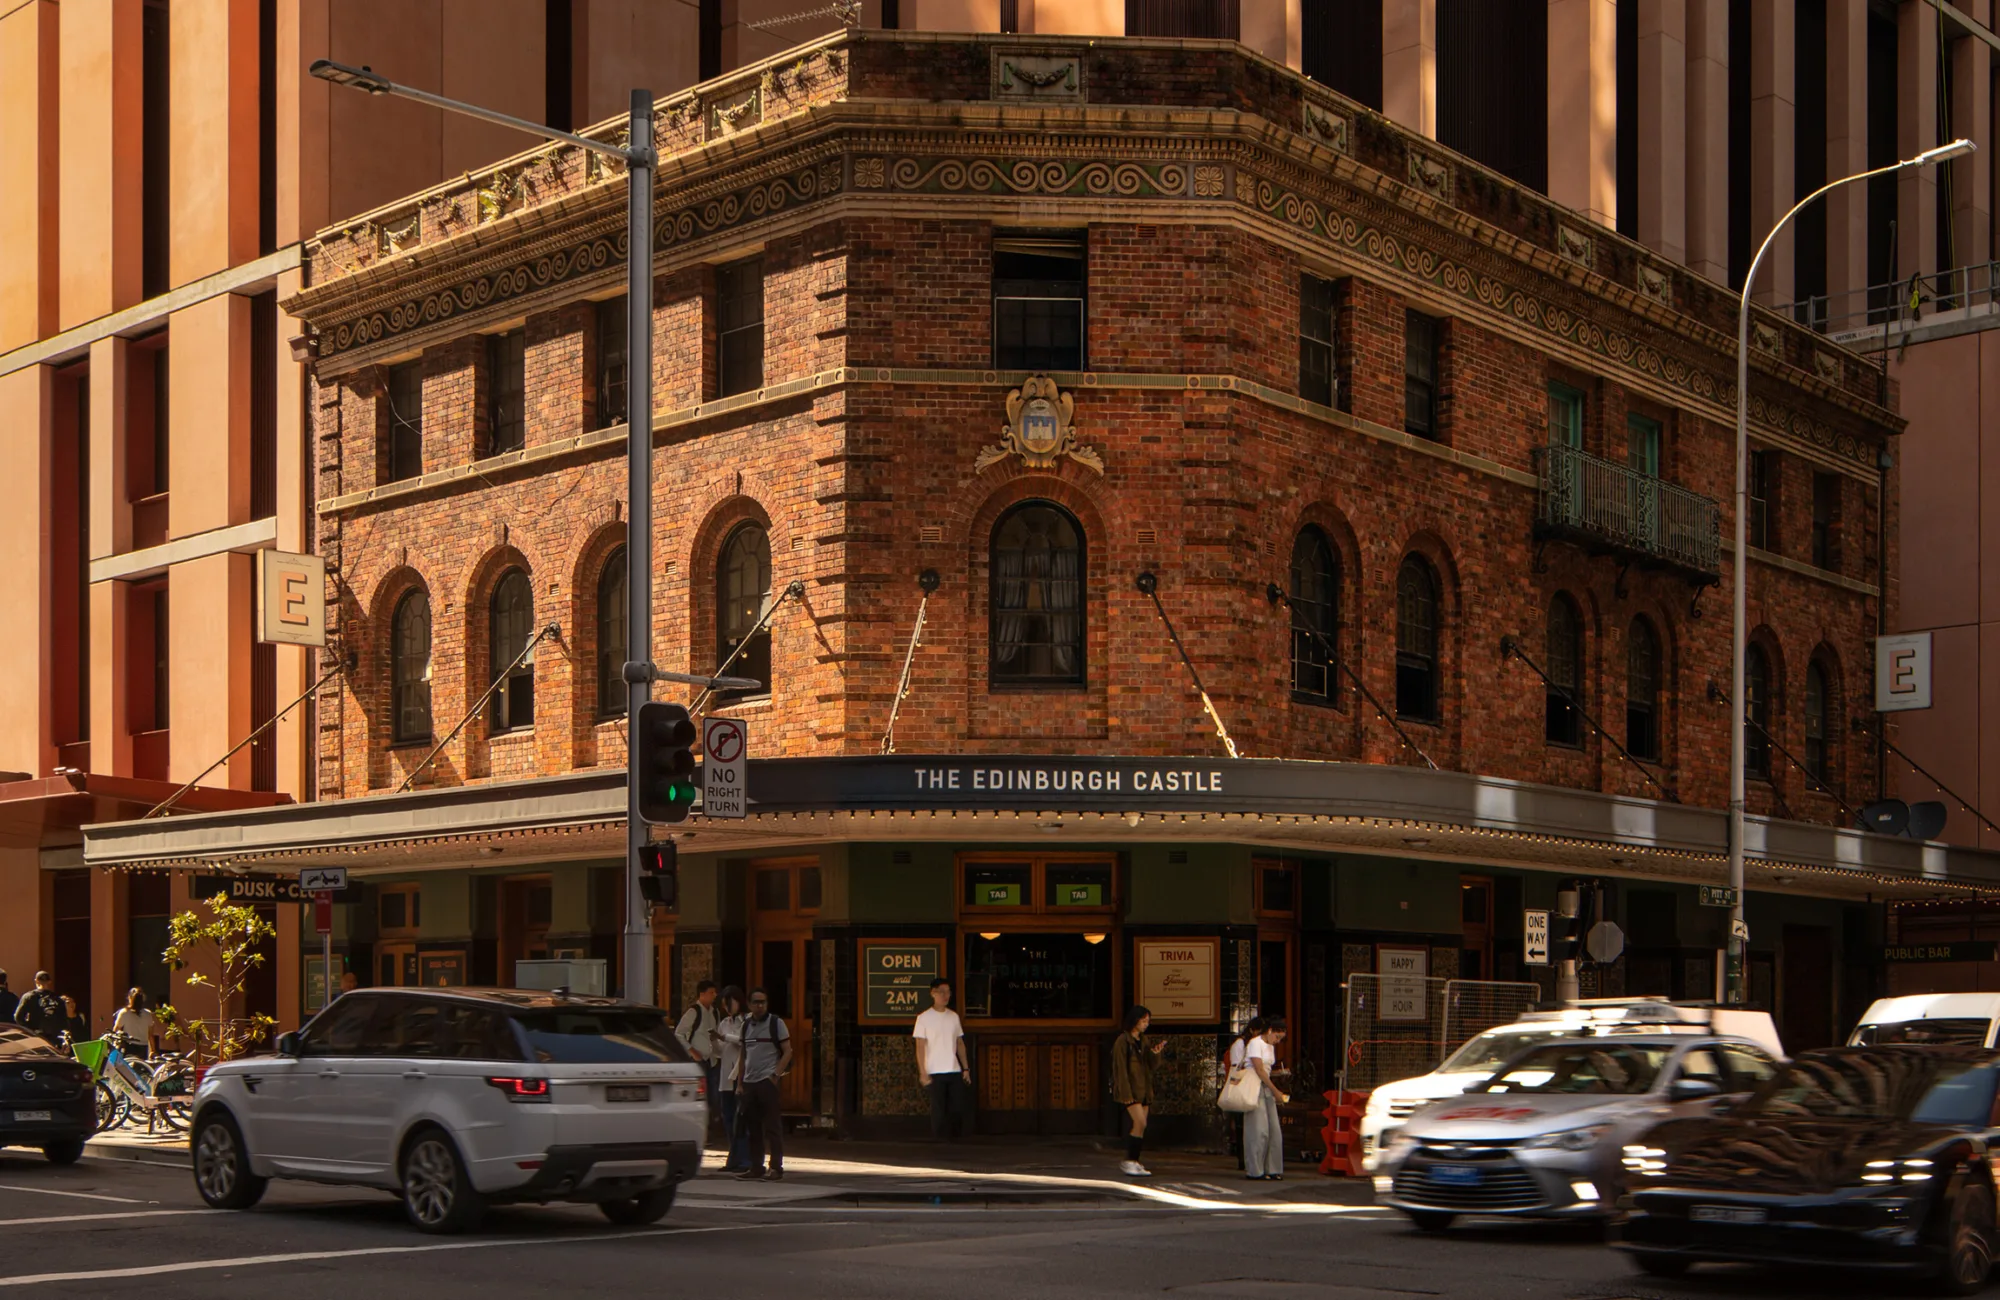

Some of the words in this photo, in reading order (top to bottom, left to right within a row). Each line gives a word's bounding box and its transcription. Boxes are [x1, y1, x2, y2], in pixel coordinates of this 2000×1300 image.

[279, 571, 308, 626] E
[1889, 649, 1916, 694] E
[712, 768, 736, 783] NO
[914, 769, 961, 789] THE
[972, 769, 1121, 792] EDINBURGH
[1133, 770, 1223, 792] CASTLE
[707, 786, 741, 798] RIGHT
[708, 800, 739, 812] TURN
[232, 880, 276, 898] DUSK
[990, 891, 1007, 899] TAB
[1071, 891, 1087, 899] TAB
[1528, 915, 1545, 928] ONE
[1527, 932, 1546, 945] WAY
[1029, 950, 1048, 959] THE
[1159, 950, 1195, 961] TRIVIA
[1884, 947, 1926, 960] PUBLIC
[1928, 946, 1951, 958] BAR
[881, 954, 922, 969] OPEN
[1391, 957, 1415, 970] HAPPY
[1023, 981, 1053, 990] CASTLE
[885, 990, 919, 1005] 2AM
[1392, 1000, 1413, 1012] HOUR
